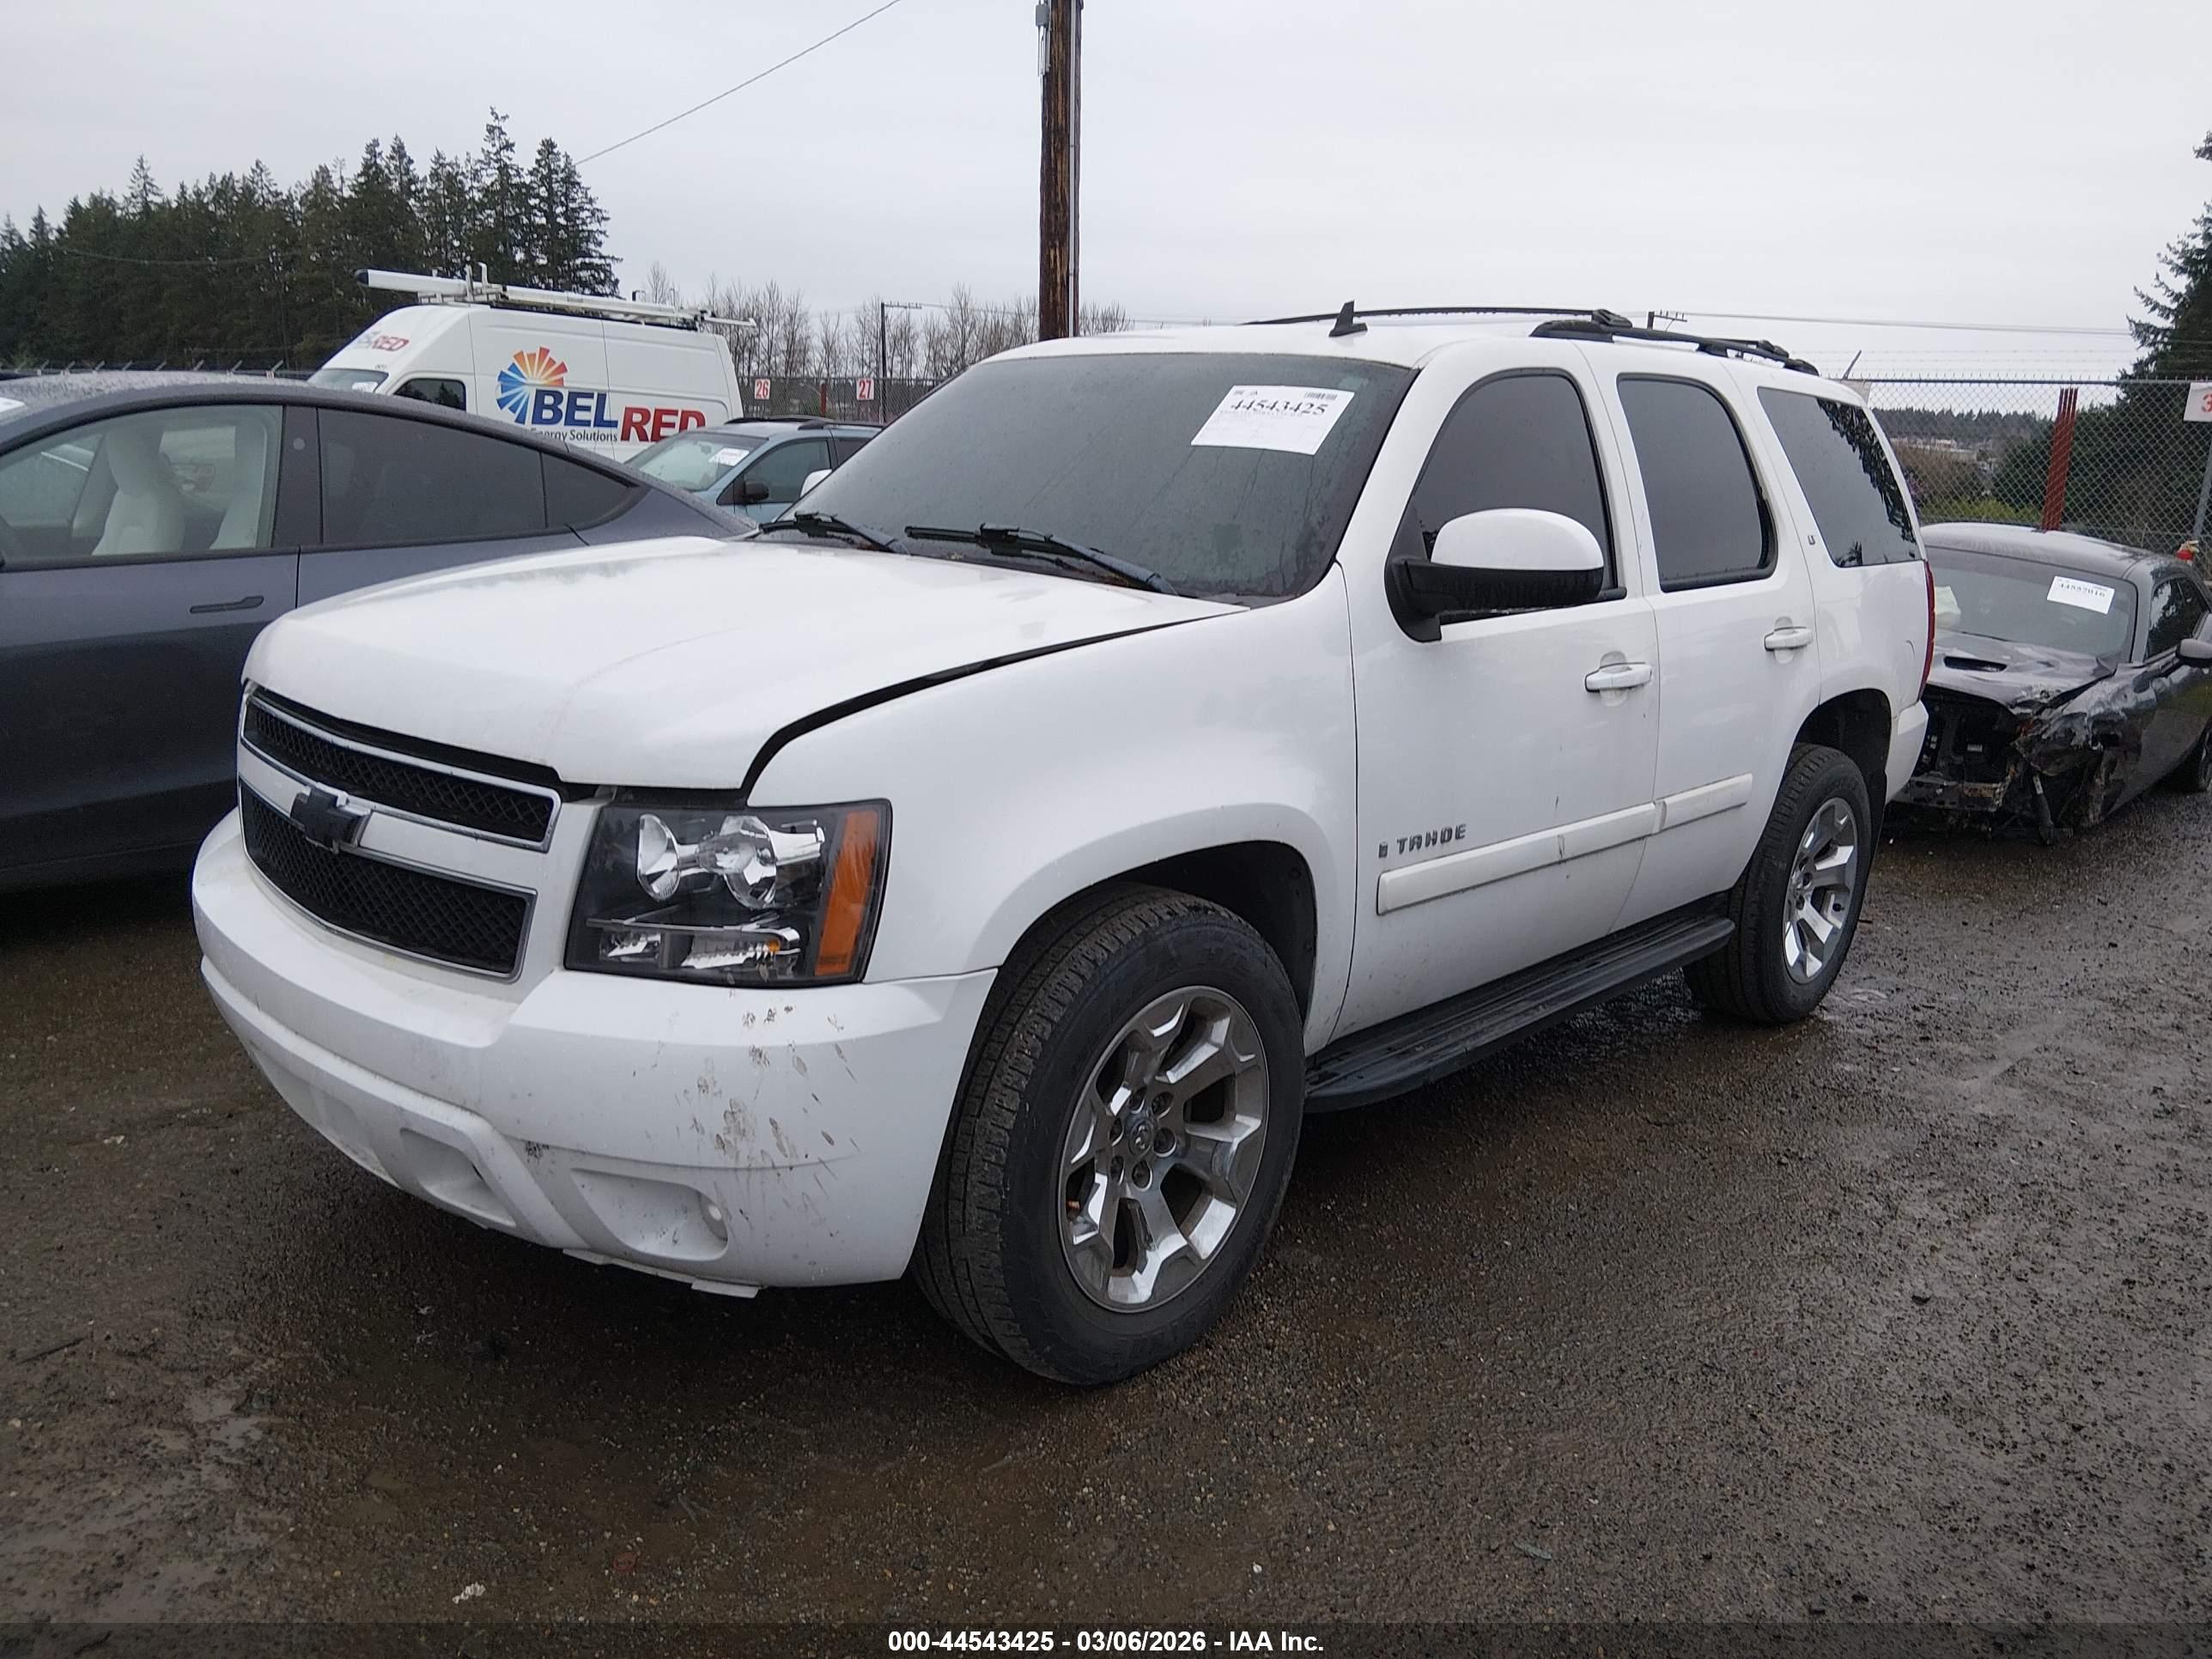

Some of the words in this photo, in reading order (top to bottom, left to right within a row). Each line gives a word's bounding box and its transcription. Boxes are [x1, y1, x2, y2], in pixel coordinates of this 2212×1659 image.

[756, 380, 769, 398] 26
[859, 380, 872, 398] 27
[531, 388, 619, 428] BEL
[1231, 398, 1328, 416] 44543425
[569, 429, 618, 442] Solutions
[1396, 823, 1467, 854] TAHOE
